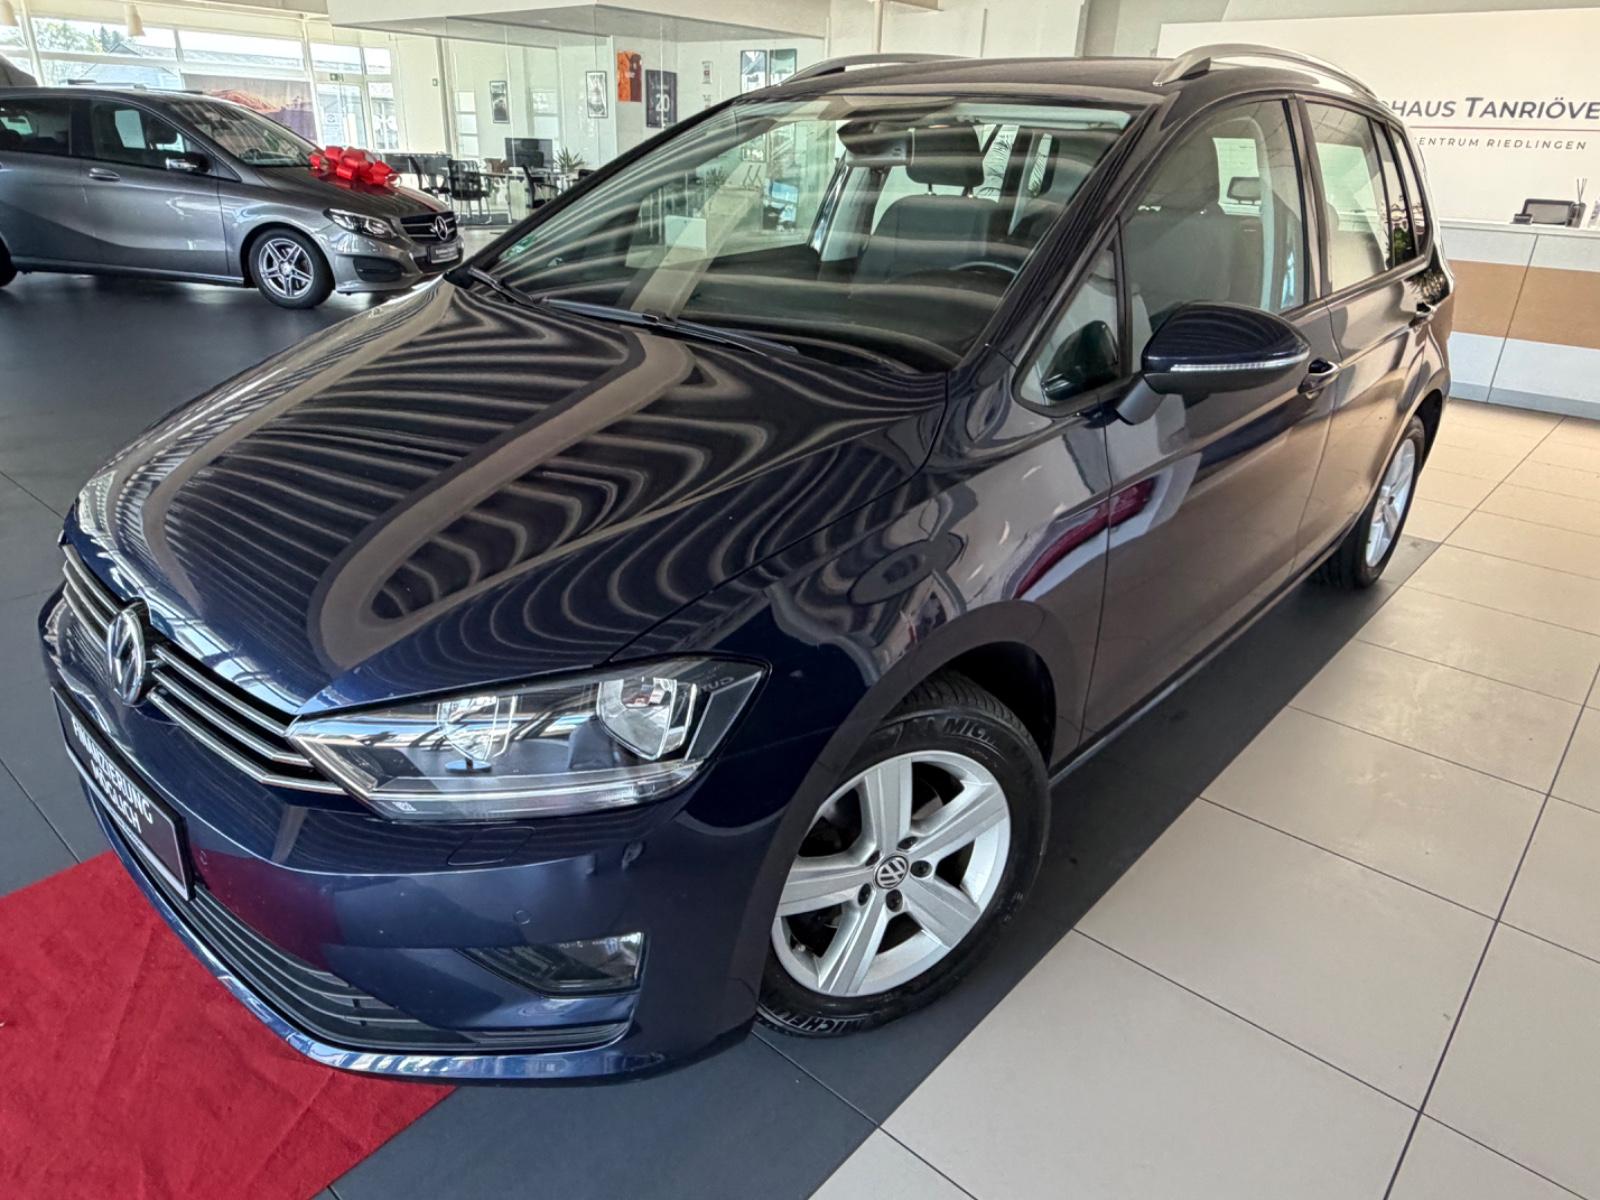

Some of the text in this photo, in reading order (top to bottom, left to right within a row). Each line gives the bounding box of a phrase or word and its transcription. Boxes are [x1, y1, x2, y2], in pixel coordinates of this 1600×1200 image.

[1392, 100, 1457, 117] HAUS
[1414, 137, 1586, 150] ENTRUM RIEDLINGEN
